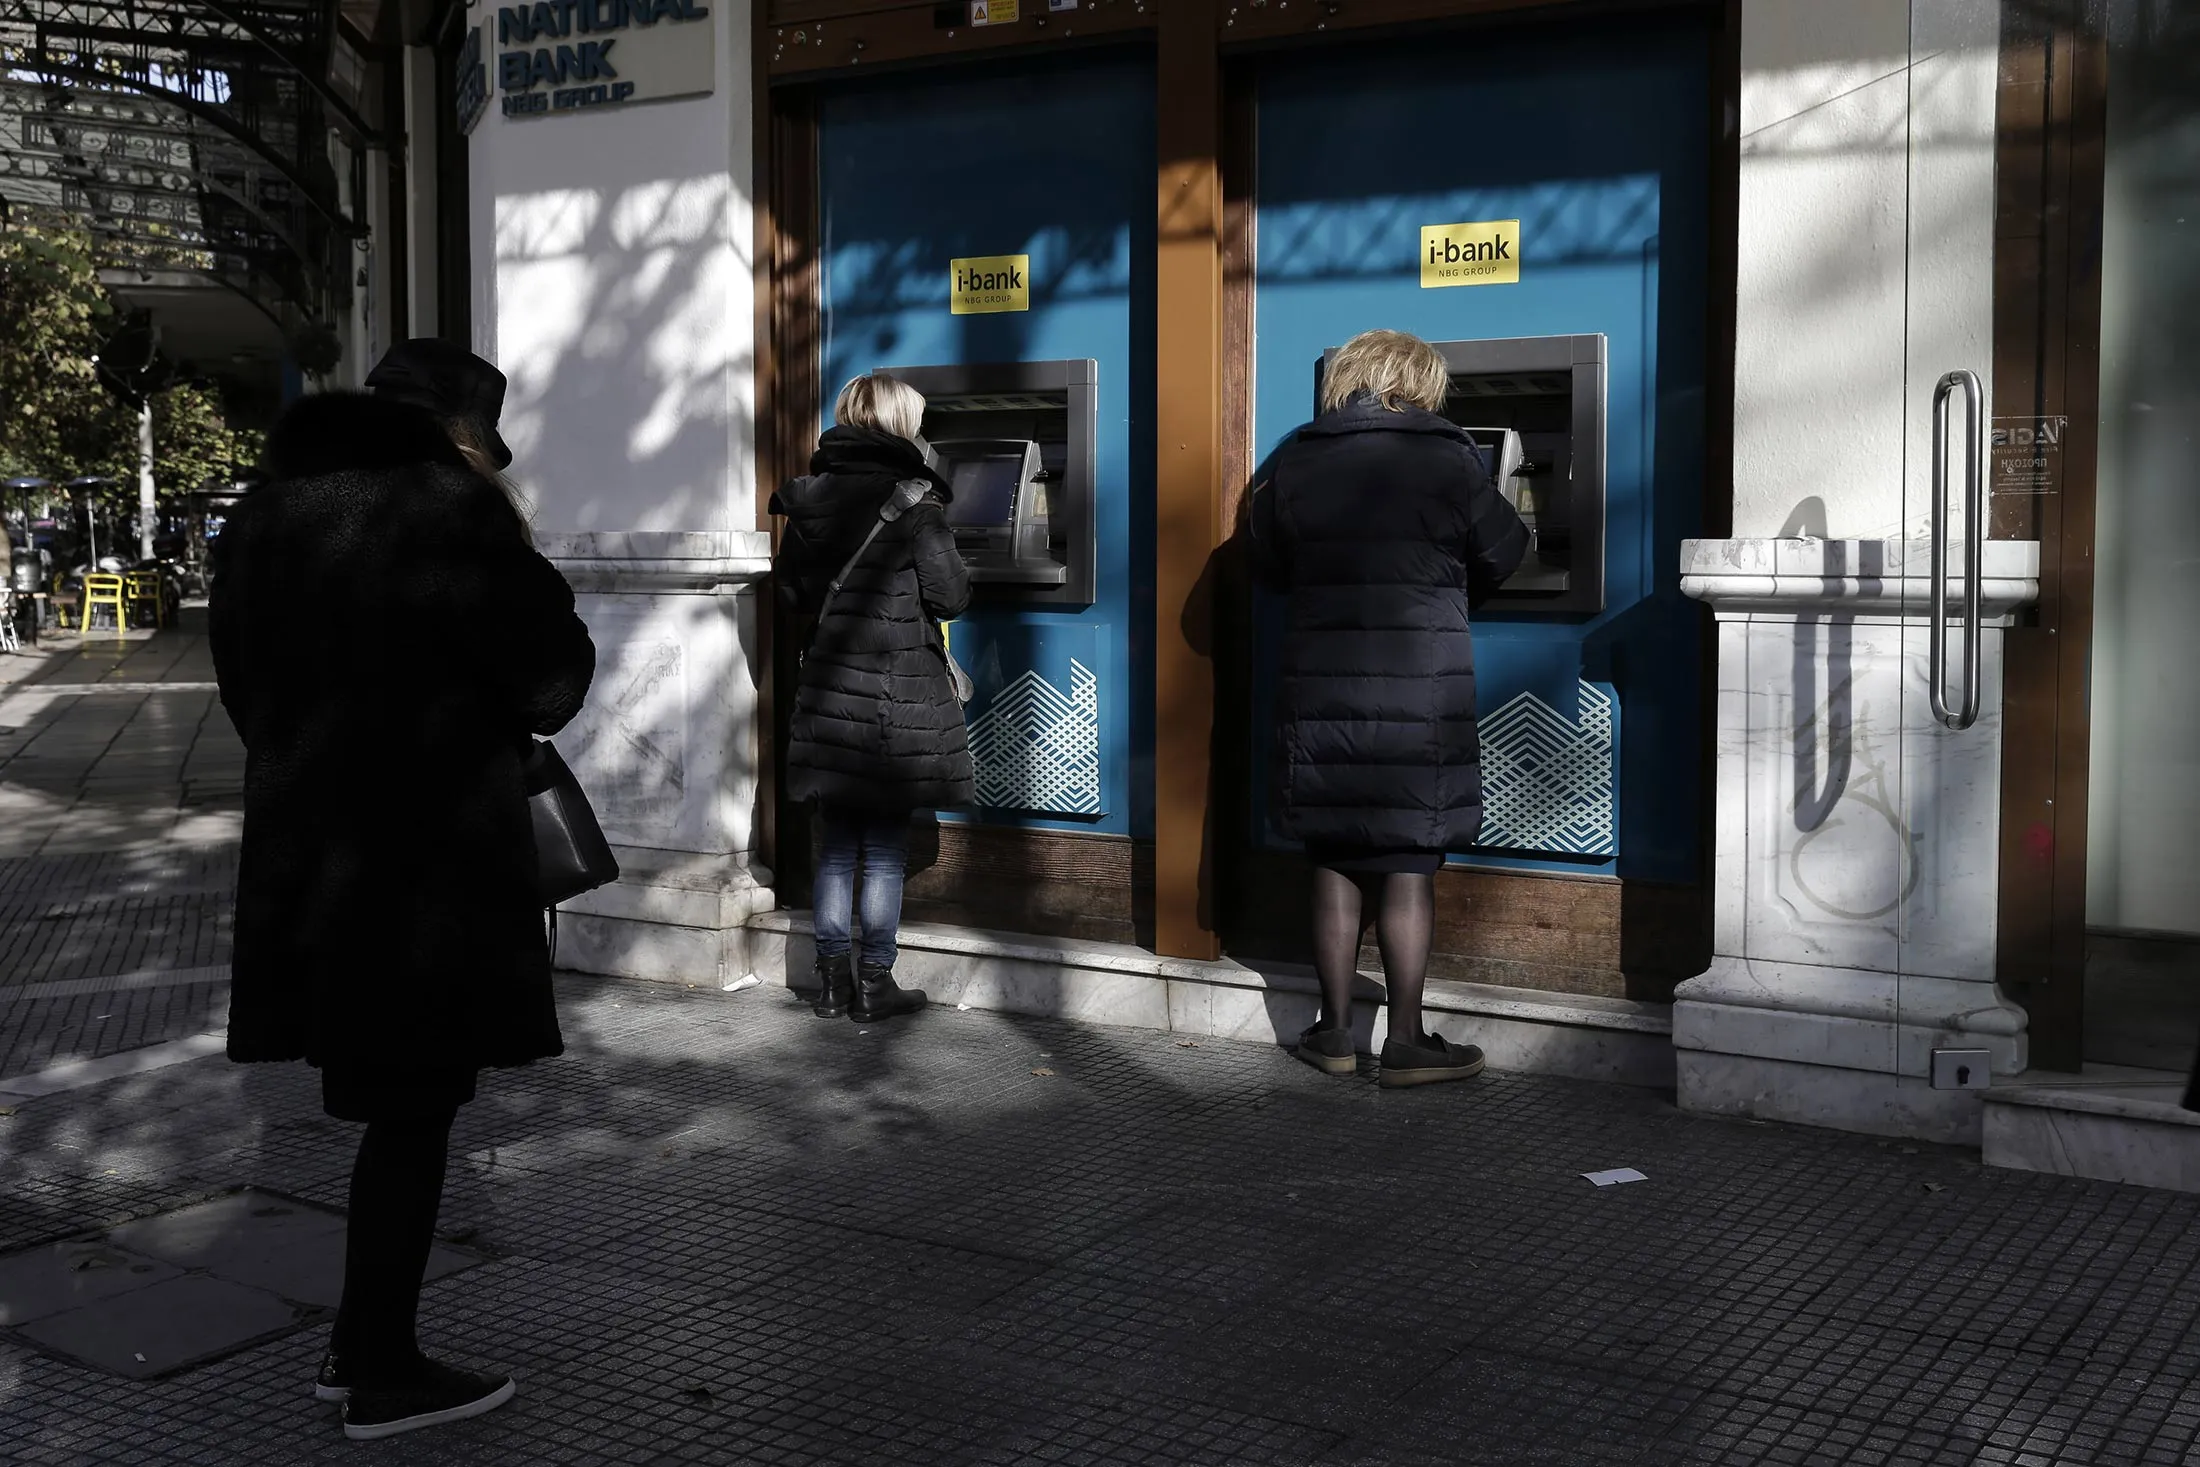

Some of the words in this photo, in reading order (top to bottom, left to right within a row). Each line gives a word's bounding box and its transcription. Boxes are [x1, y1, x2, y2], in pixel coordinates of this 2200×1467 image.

[498, 39, 617, 90] BANK
[502, 93, 548, 115] NBG
[553, 81, 635, 109] GROUP
[1430, 234, 1510, 264] i-bank
[958, 265, 1022, 292] i-bank
[1438, 268, 1459, 277] NBG
[1463, 266, 1497, 276] GROUP
[964, 296, 981, 305] NBG
[984, 295, 1011, 303] GROUP
